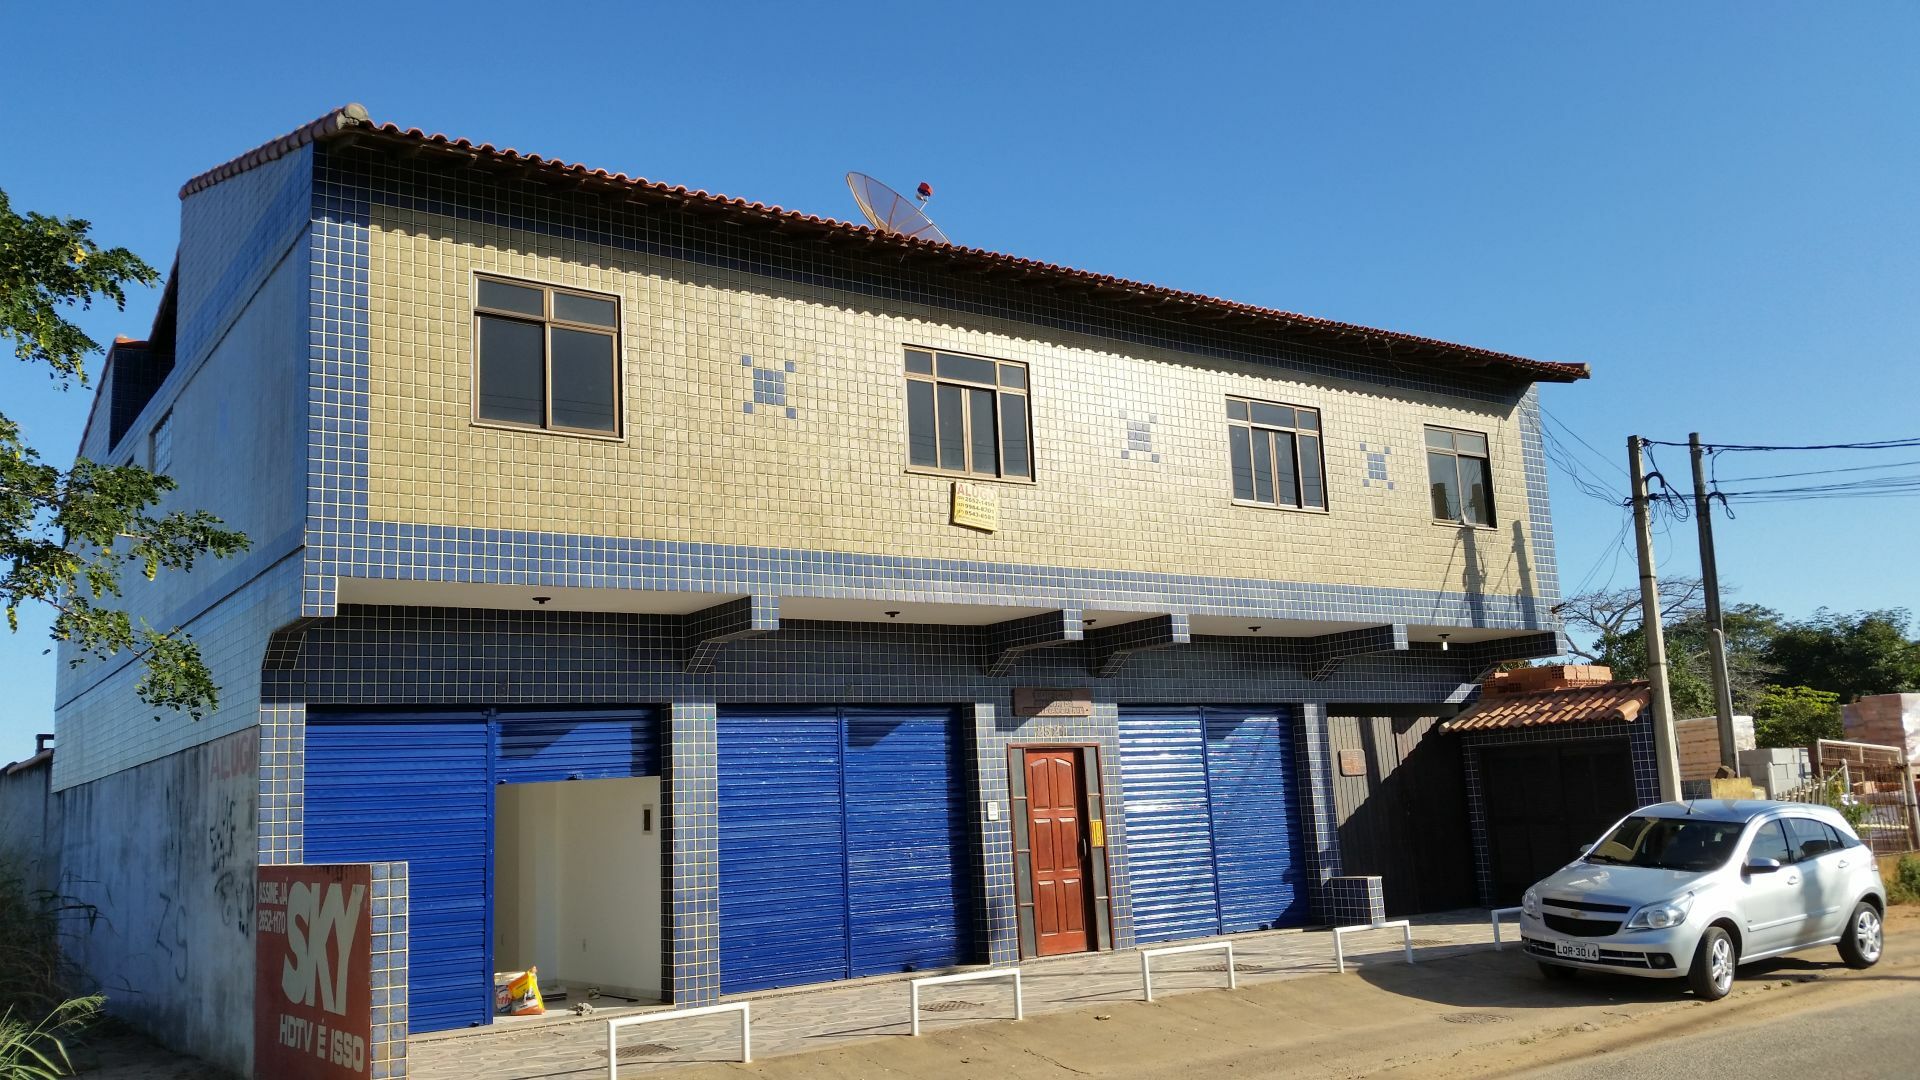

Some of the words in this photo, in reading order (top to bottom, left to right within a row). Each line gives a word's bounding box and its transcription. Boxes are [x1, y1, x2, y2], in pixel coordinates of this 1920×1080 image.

[258, 881, 279, 904] ASSINE
[281, 881, 367, 1017] SKY
[279, 1013, 314, 1053] HDTV
[316, 1017, 327, 1060] É
[330, 1028, 365, 1073] ISSO
